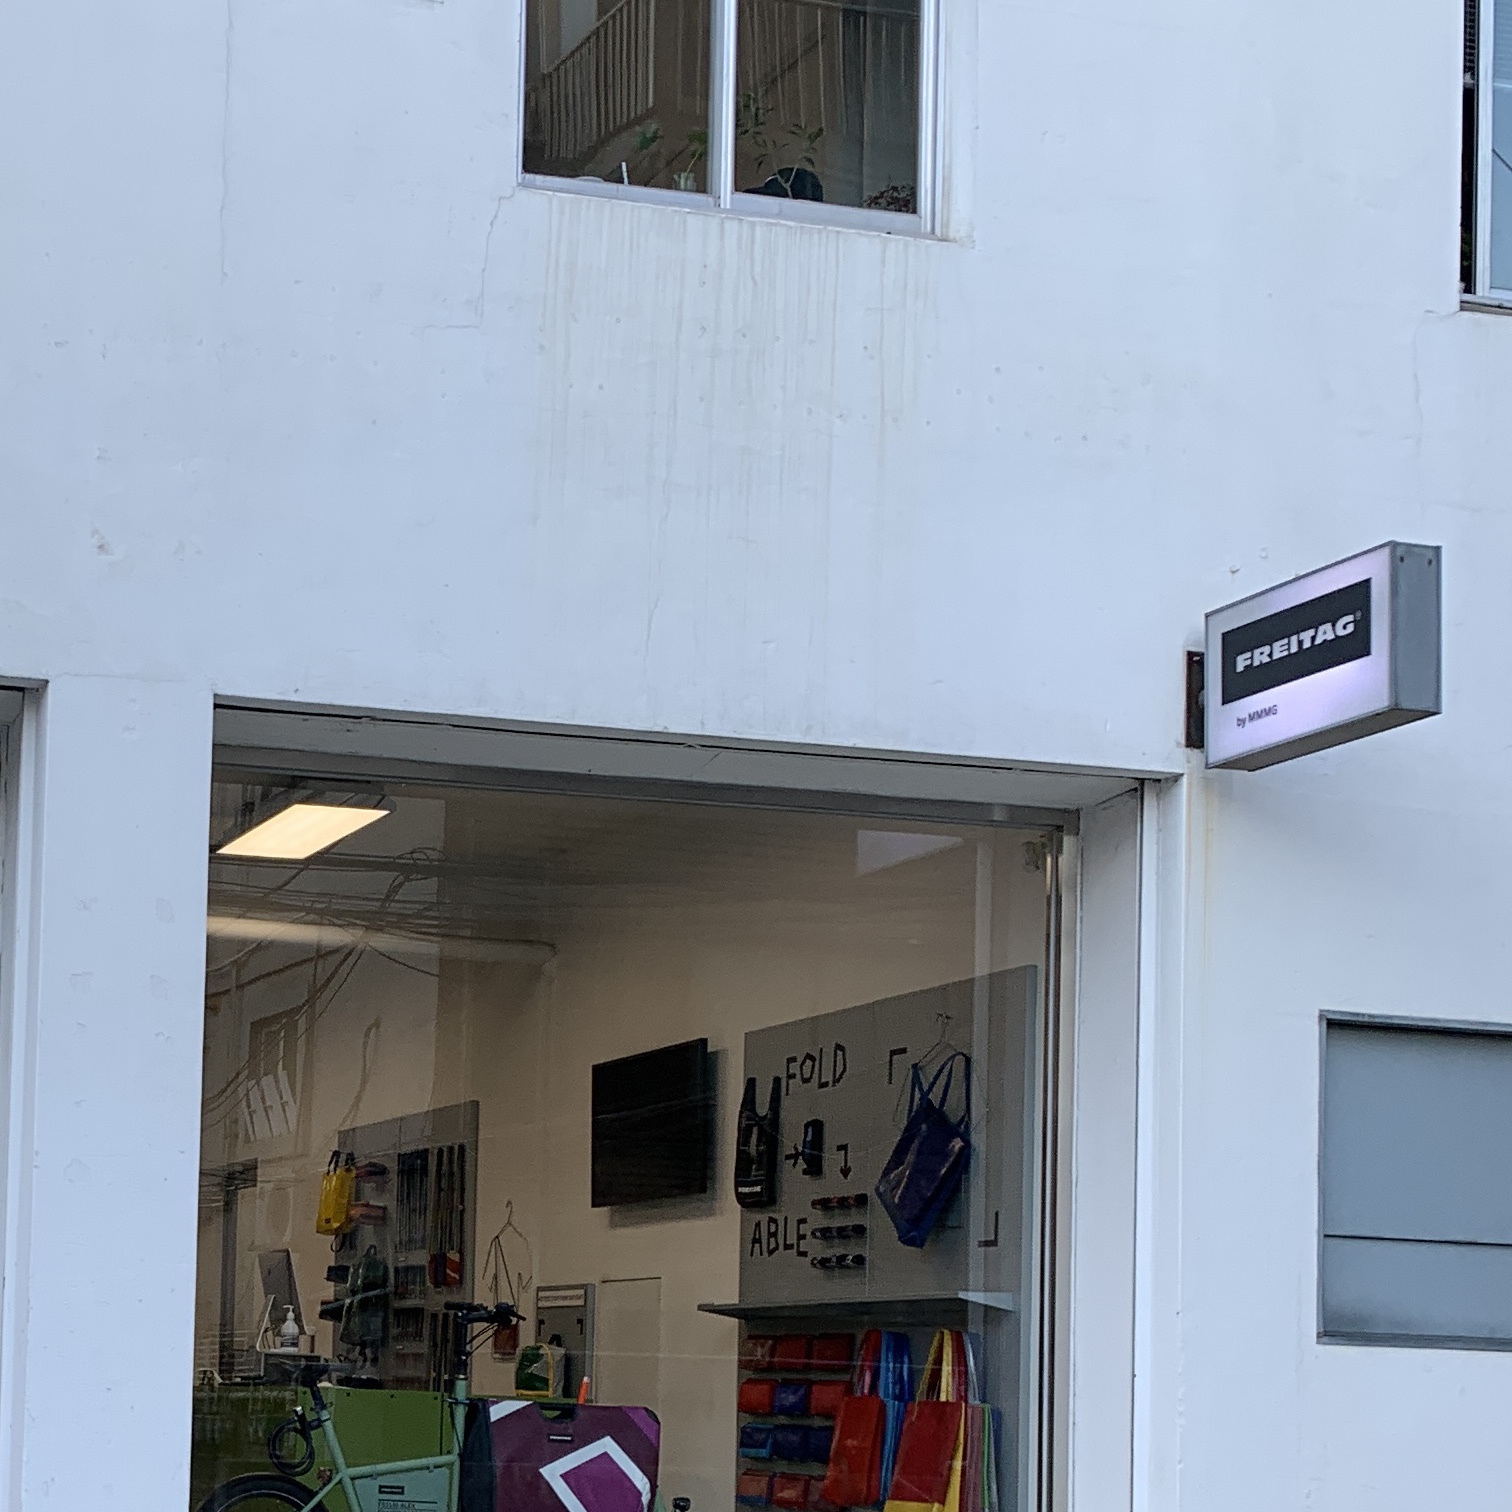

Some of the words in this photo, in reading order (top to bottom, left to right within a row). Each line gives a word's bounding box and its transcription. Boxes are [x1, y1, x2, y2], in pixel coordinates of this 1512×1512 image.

[1235, 613, 1355, 673] FREITAG
[1236, 716, 1247, 729] by
[1248, 704, 1278, 723] MMMG
[785, 1042, 848, 1097] FOLD
[750, 1216, 809, 1258] ABLE
